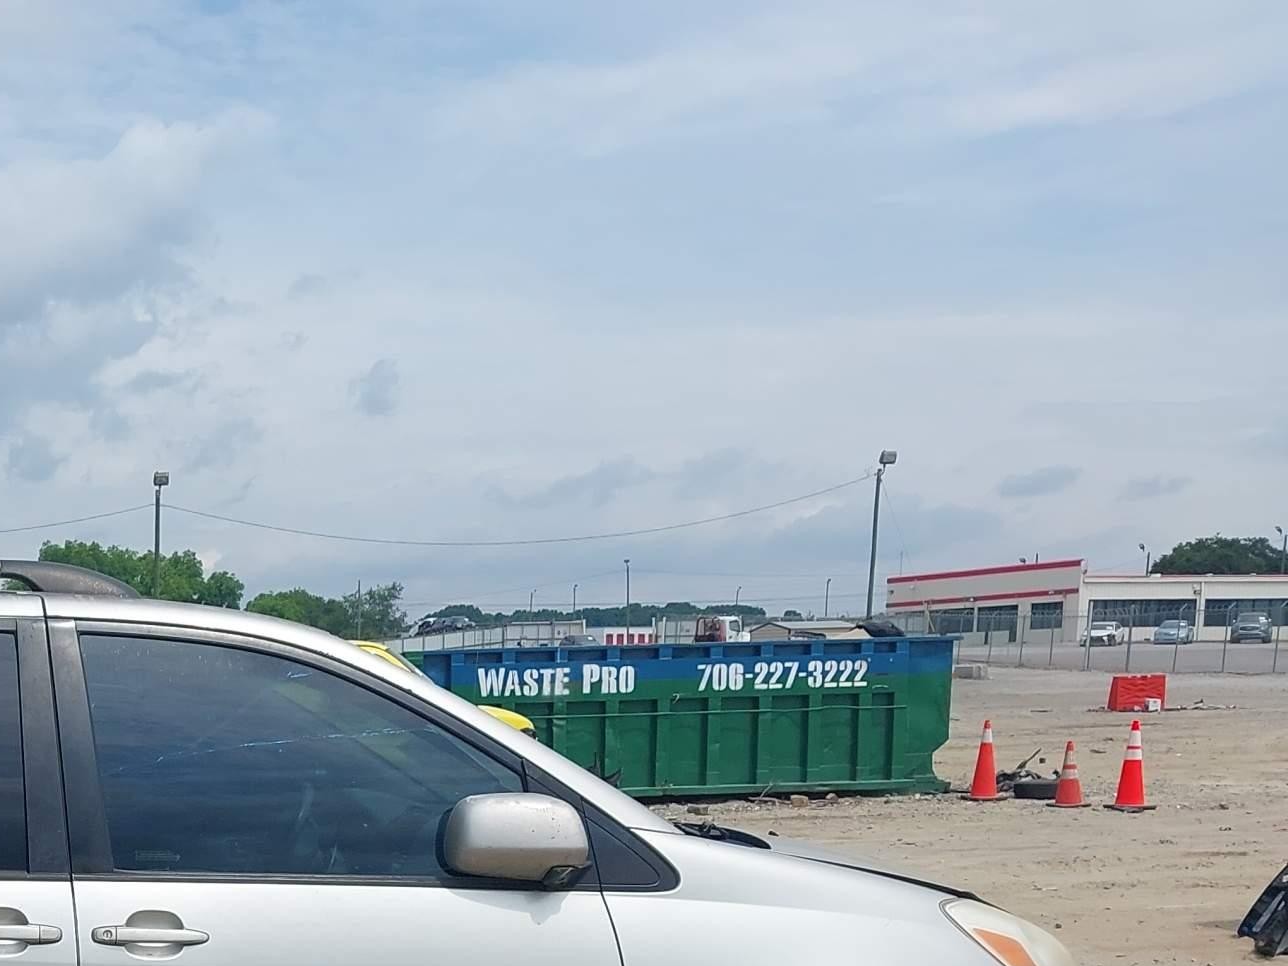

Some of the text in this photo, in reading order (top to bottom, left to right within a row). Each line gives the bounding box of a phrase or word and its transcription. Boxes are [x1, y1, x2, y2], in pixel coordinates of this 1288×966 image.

[477, 664, 635, 697] WASTE PRO
[697, 660, 868, 690] 706-227-3222
